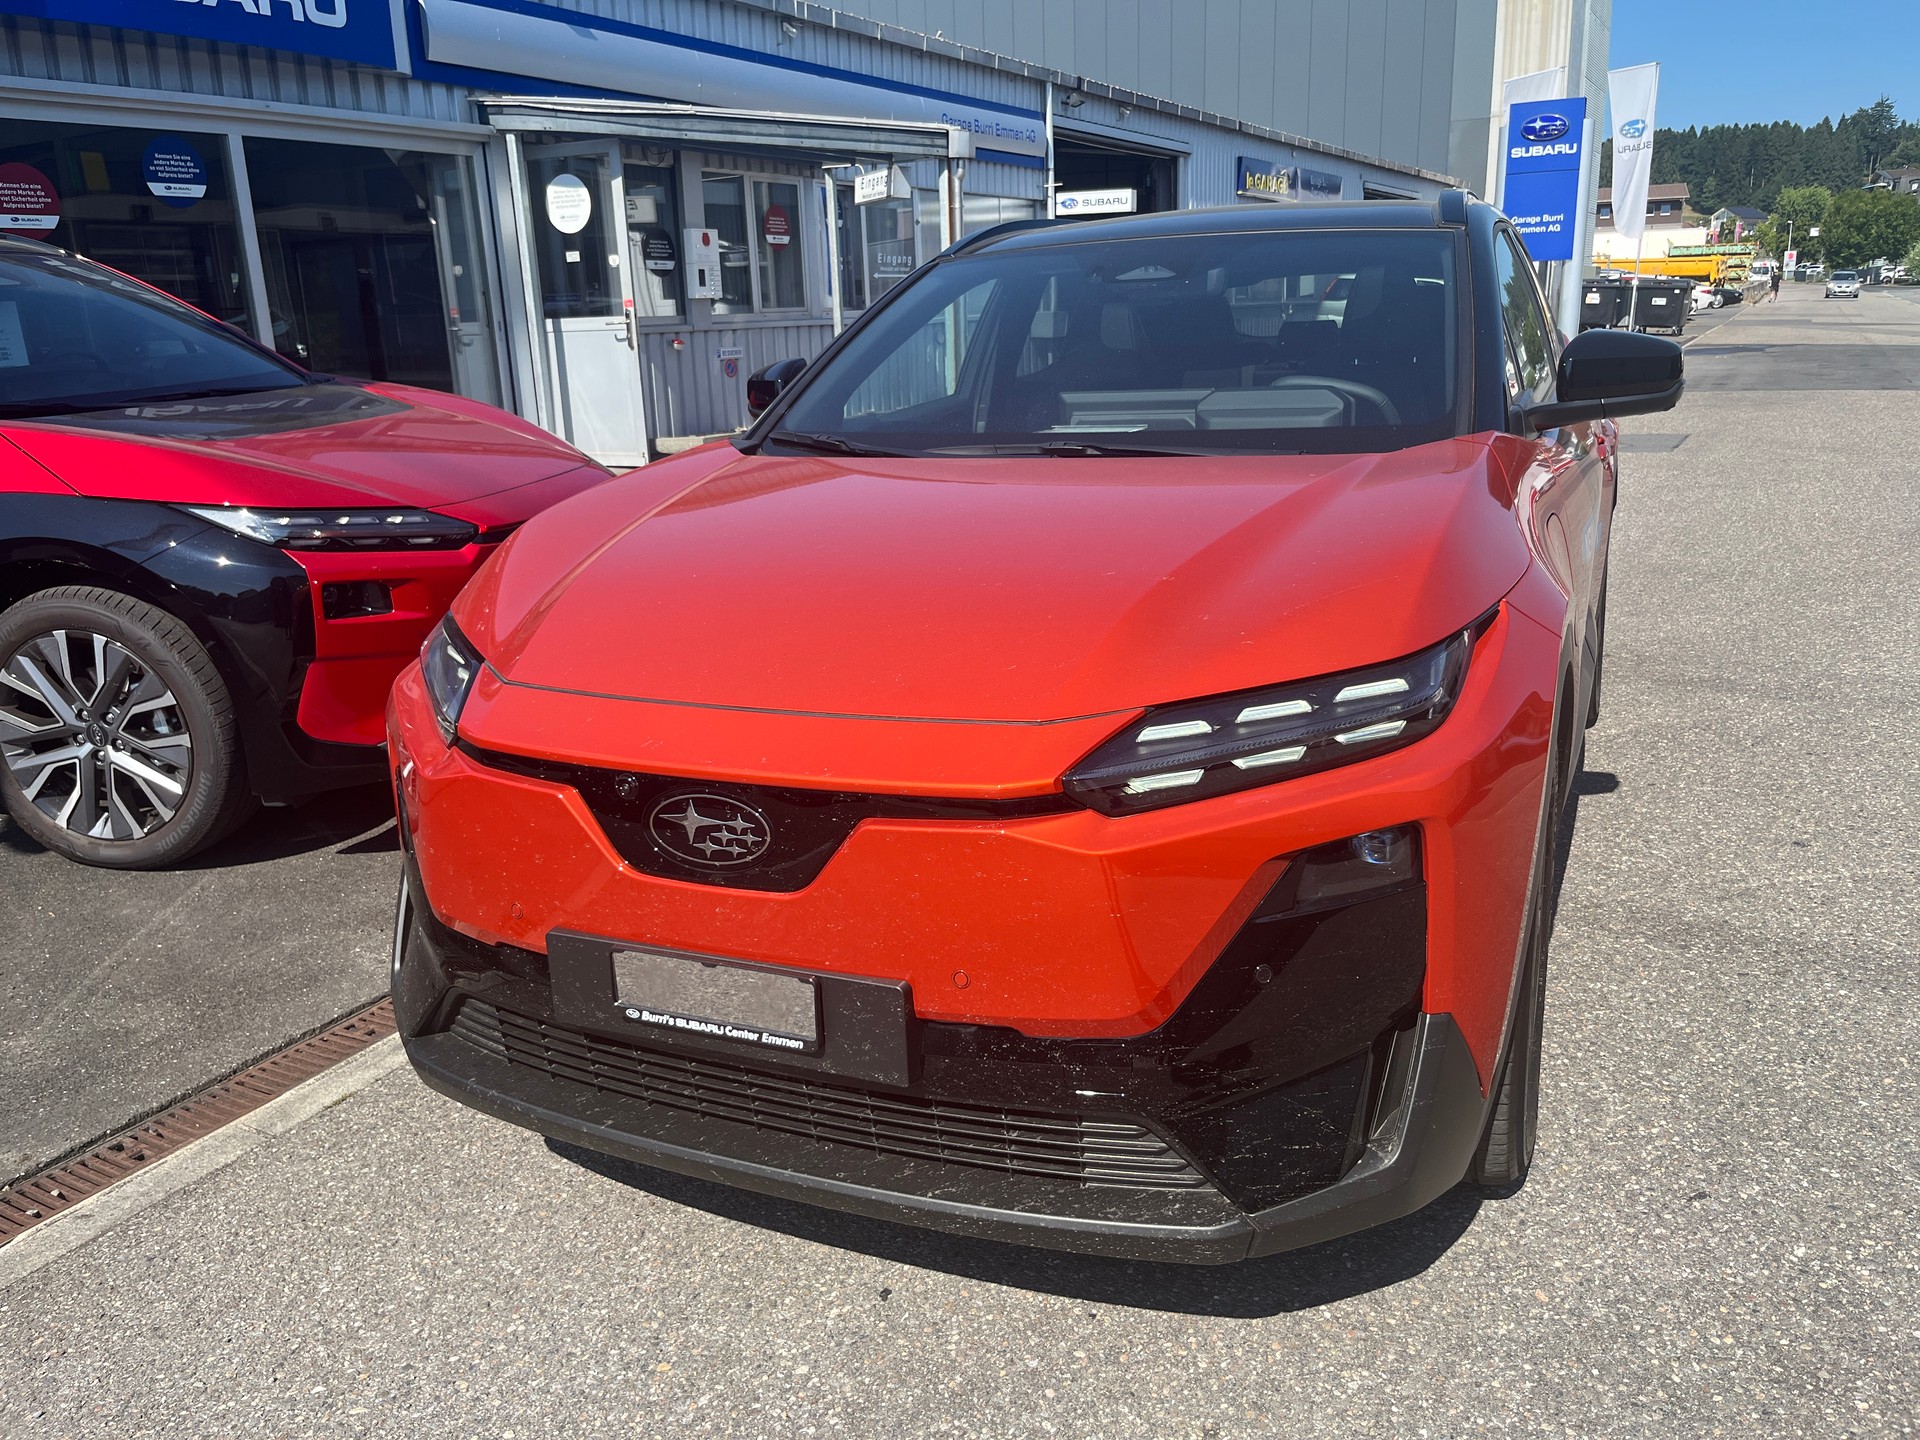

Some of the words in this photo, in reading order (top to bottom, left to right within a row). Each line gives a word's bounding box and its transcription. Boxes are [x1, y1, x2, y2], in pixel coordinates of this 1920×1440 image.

[974, 119, 993, 135] Burri
[995, 123, 1024, 140] Emmen
[1026, 129, 1036, 143] AG
[1510, 143, 1578, 158] SUBARU
[861, 175, 888, 190] Eingang
[1246, 172, 1254, 189] le
[1082, 197, 1128, 207] SUBARU
[1511, 215, 1541, 225] Garage
[1543, 213, 1564, 223] Burri
[1547, 224, 1561, 233] AG
[877, 252, 912, 266] Eingang
[154, 769, 213, 854] BRIDGESTONE
[641, 1010, 675, 1026] Burri's
[675, 1017, 725, 1036] SUBARU
[725, 1025, 759, 1041] Center
[761, 1032, 804, 1050] Emmen
